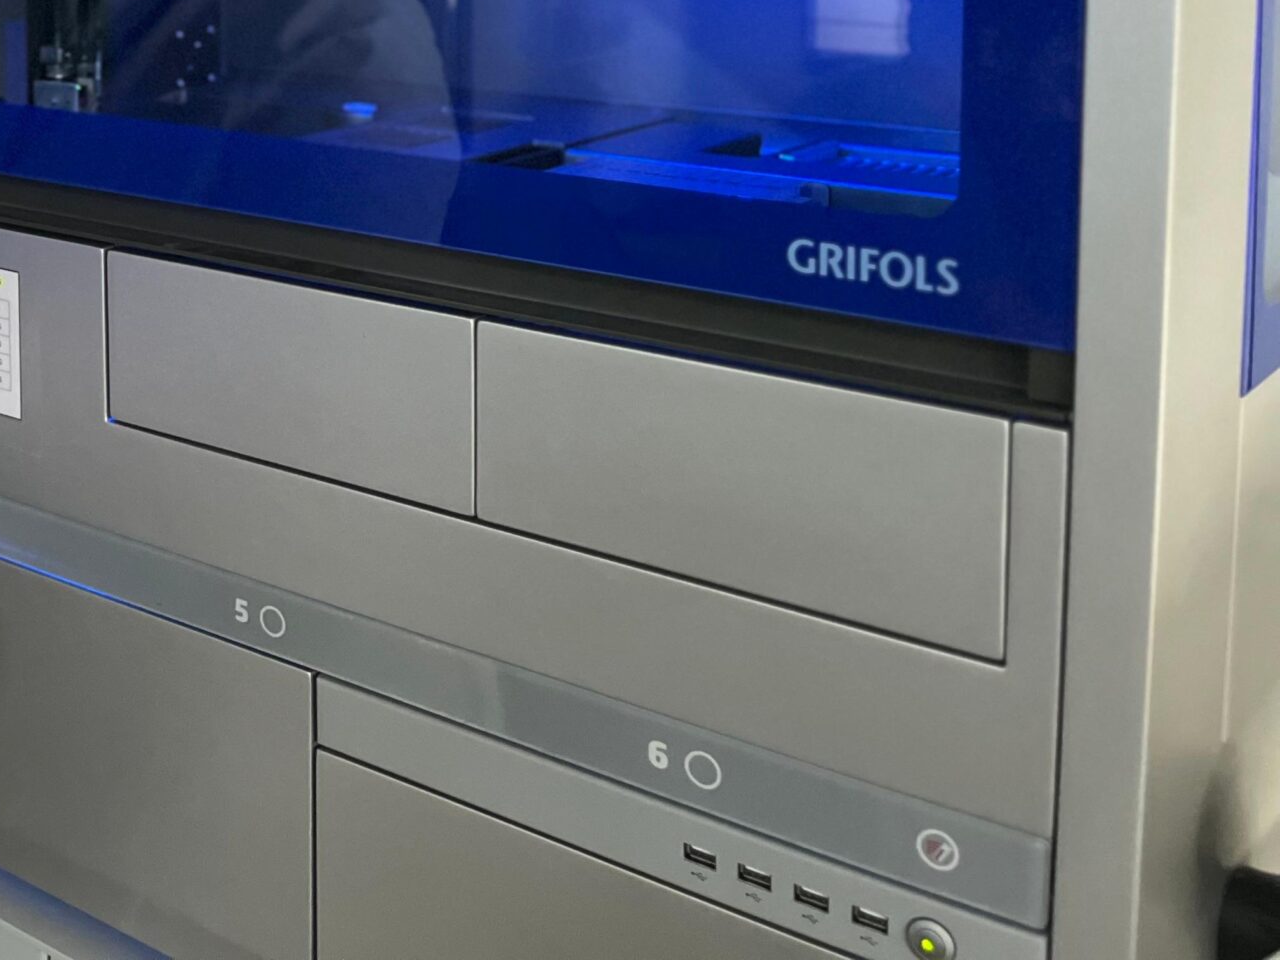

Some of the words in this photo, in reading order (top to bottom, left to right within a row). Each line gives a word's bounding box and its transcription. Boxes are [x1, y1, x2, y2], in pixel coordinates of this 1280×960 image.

[787, 238, 959, 296] GRIFOLS
[235, 597, 249, 623] 5
[648, 740, 669, 770] 6
